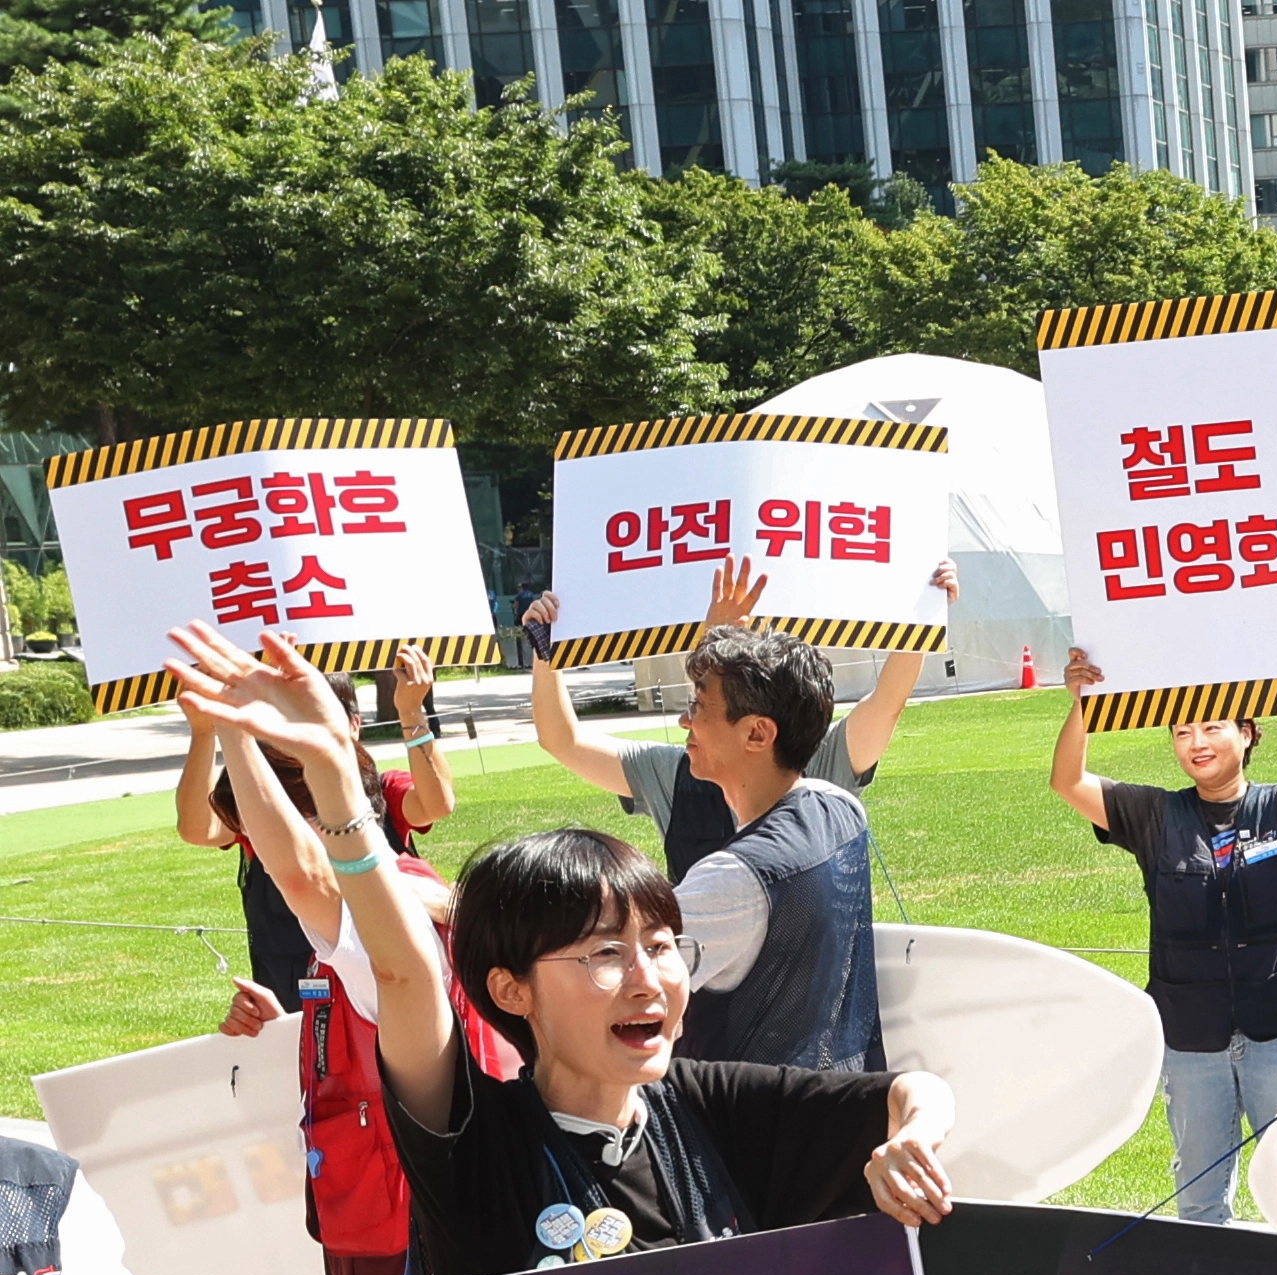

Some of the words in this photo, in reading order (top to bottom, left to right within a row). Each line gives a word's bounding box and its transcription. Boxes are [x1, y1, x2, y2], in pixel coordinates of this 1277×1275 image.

[1120, 419, 1262, 502] 철도
[124, 470, 407, 562] 무궁화호
[606, 499, 733, 575] 안전
[755, 499, 893, 565] 위협
[210, 555, 354, 626] 축소
